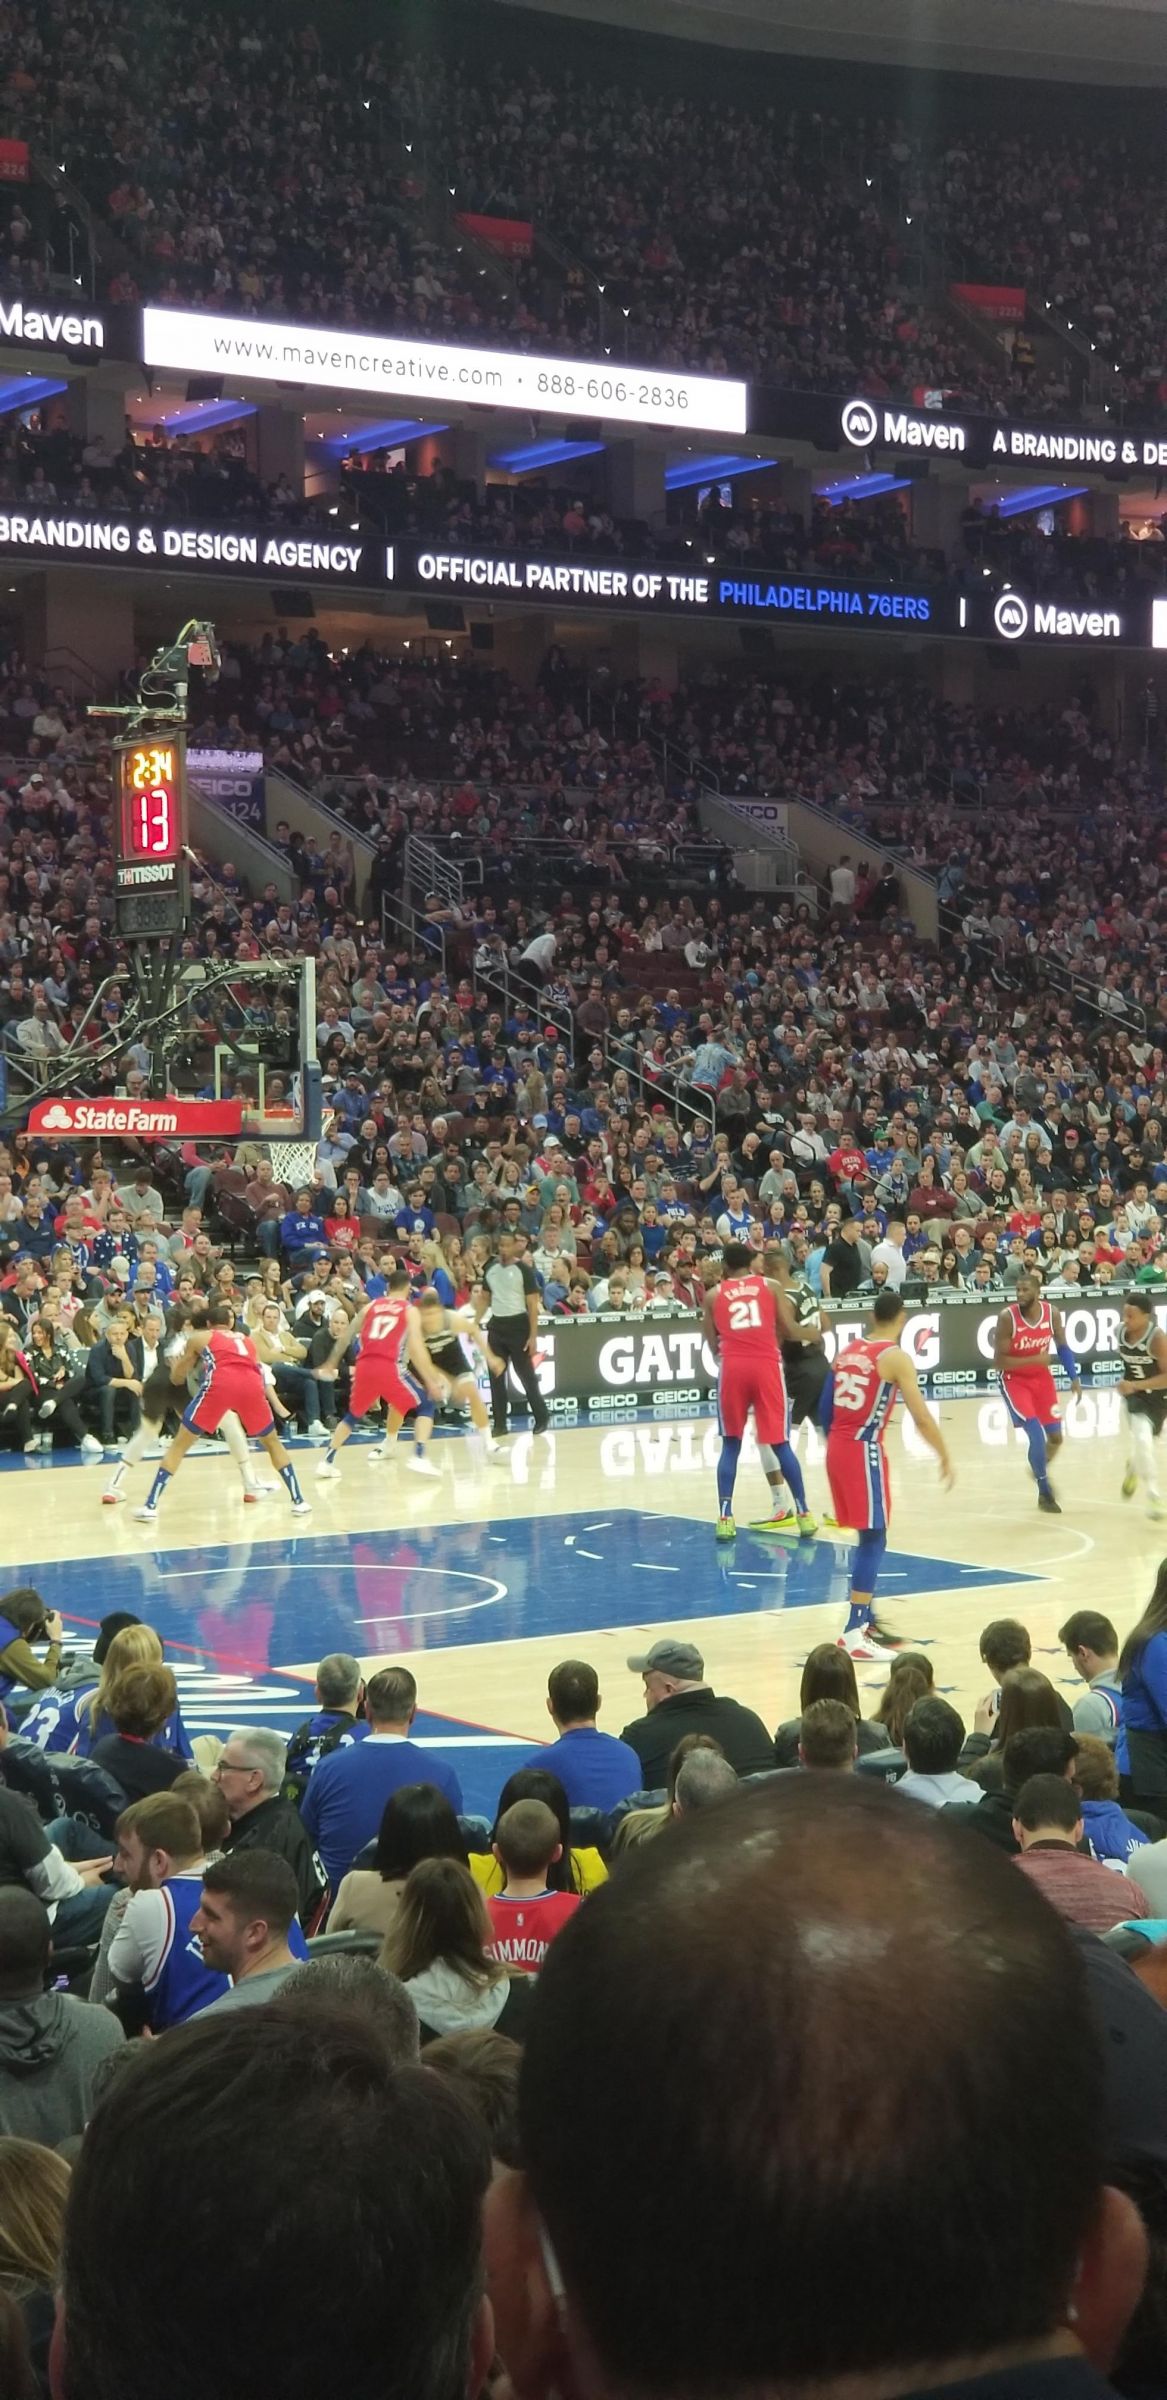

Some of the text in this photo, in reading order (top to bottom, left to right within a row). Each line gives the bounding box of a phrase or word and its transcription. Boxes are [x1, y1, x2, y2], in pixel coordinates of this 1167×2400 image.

[0, 302, 104, 347] Maven
[213, 337, 689, 409] www.mavencreative.com 888-606-2836
[884, 411, 966, 451] Maven
[992, 428, 1008, 453] A
[1011, 431, 1116, 463] BRANDING
[1121, 440, 1138, 464] &
[0, 515, 363, 572] BRANDING & DESIGN AGENCY
[418, 554, 930, 621] OFFICIAL PARTNER OF THE PHILADELPHIA 76ERS
[1034, 603, 1121, 637] Maven
[133, 749, 173, 789] 2:34
[140, 788, 169, 851] 13
[133, 863, 176, 884] TISSOT
[369, 1315, 399, 1340] 17
[728, 1300, 762, 1330] 21
[233, 1339, 249, 1357] 1
[932, 1370, 977, 1384] GEICO
[1130, 1364, 1146, 1379] 3
[588, 1393, 638, 1409] GEICO
[652, 1388, 701, 1405] GEICO
[833, 1370, 870, 1411] 25
